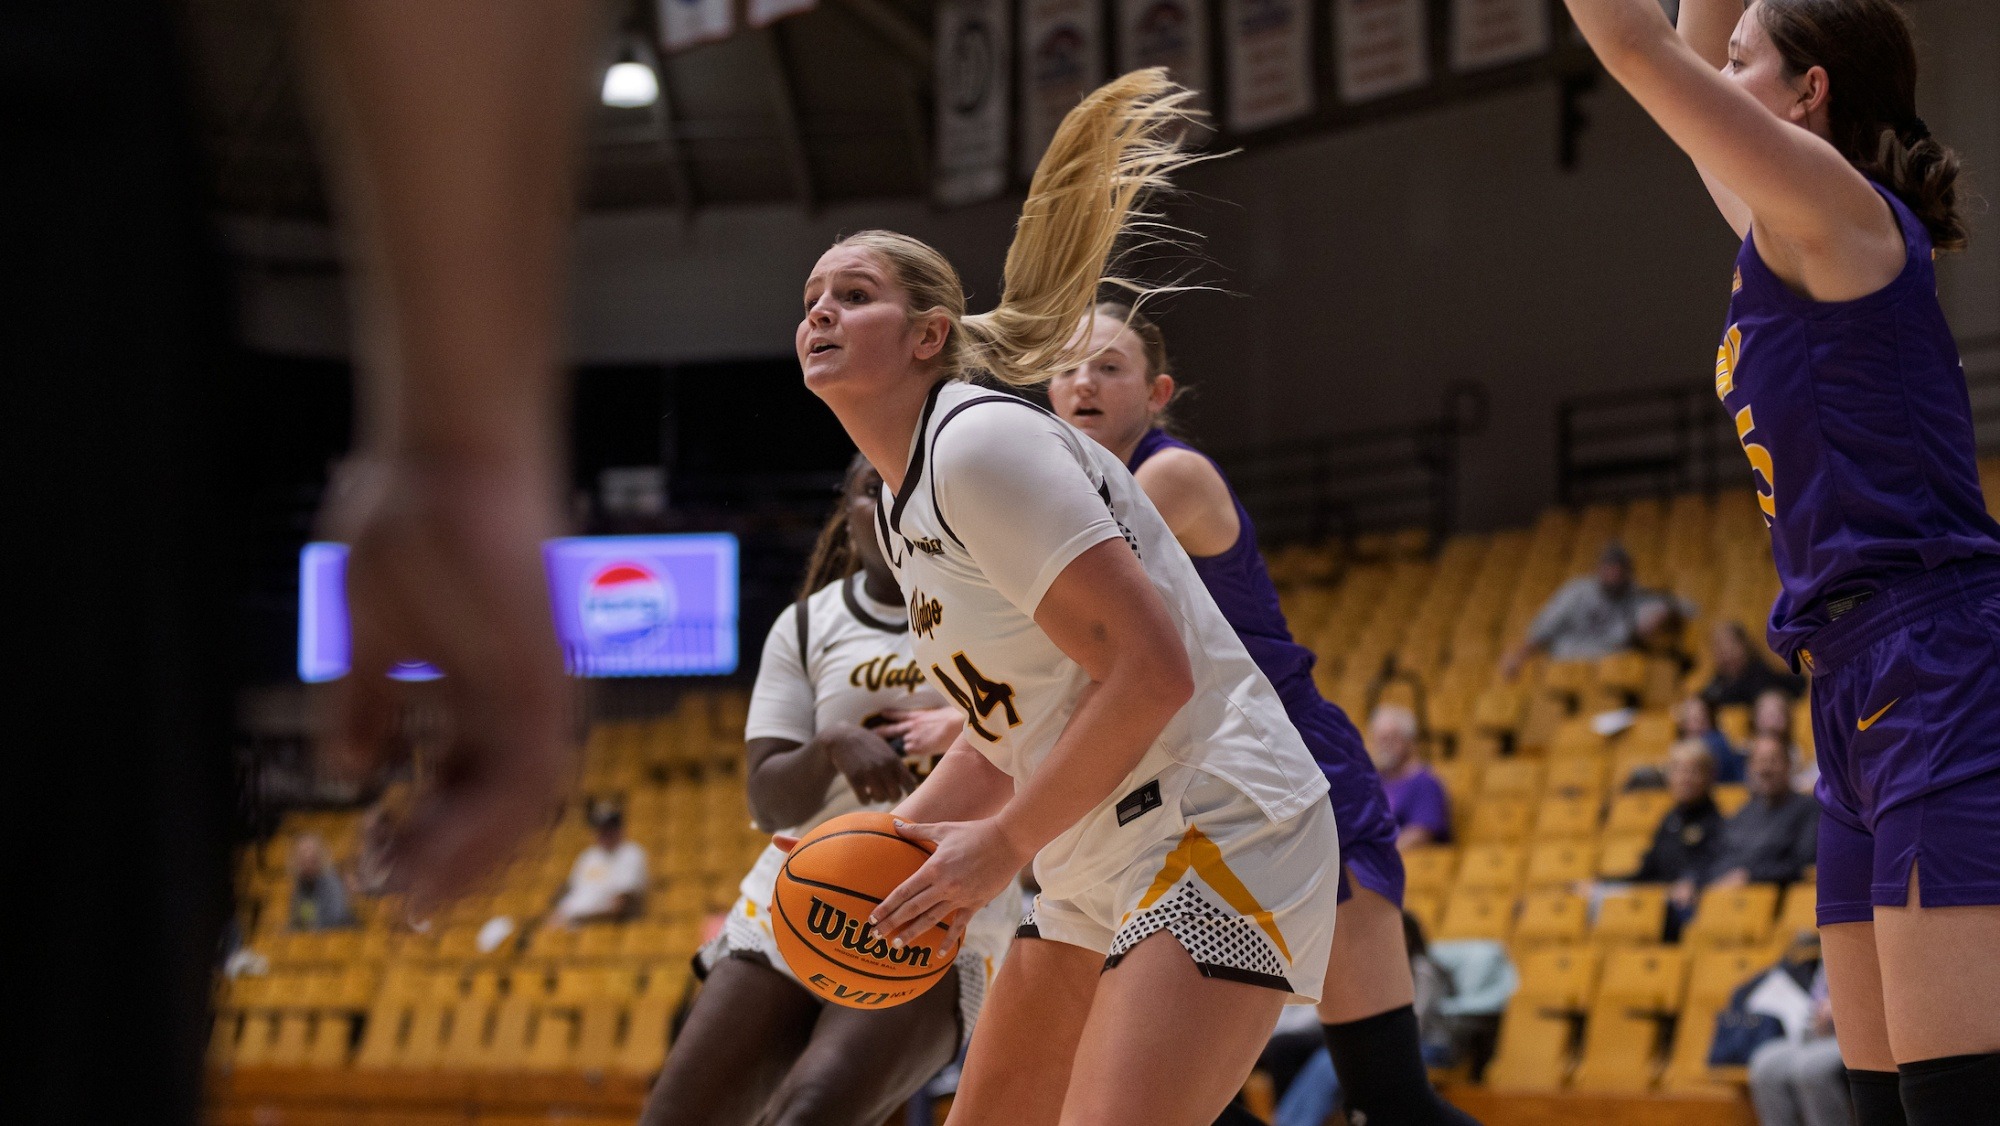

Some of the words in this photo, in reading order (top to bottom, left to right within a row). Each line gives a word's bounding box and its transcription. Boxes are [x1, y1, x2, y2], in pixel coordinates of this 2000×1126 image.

[910, 585, 943, 641] Valpo
[849, 653, 926, 694] Valp
[931, 650, 1023, 744] 14
[1144, 791, 1153, 803] XL
[806, 896, 933, 968] Wilson
[808, 973, 890, 1005] EVO
